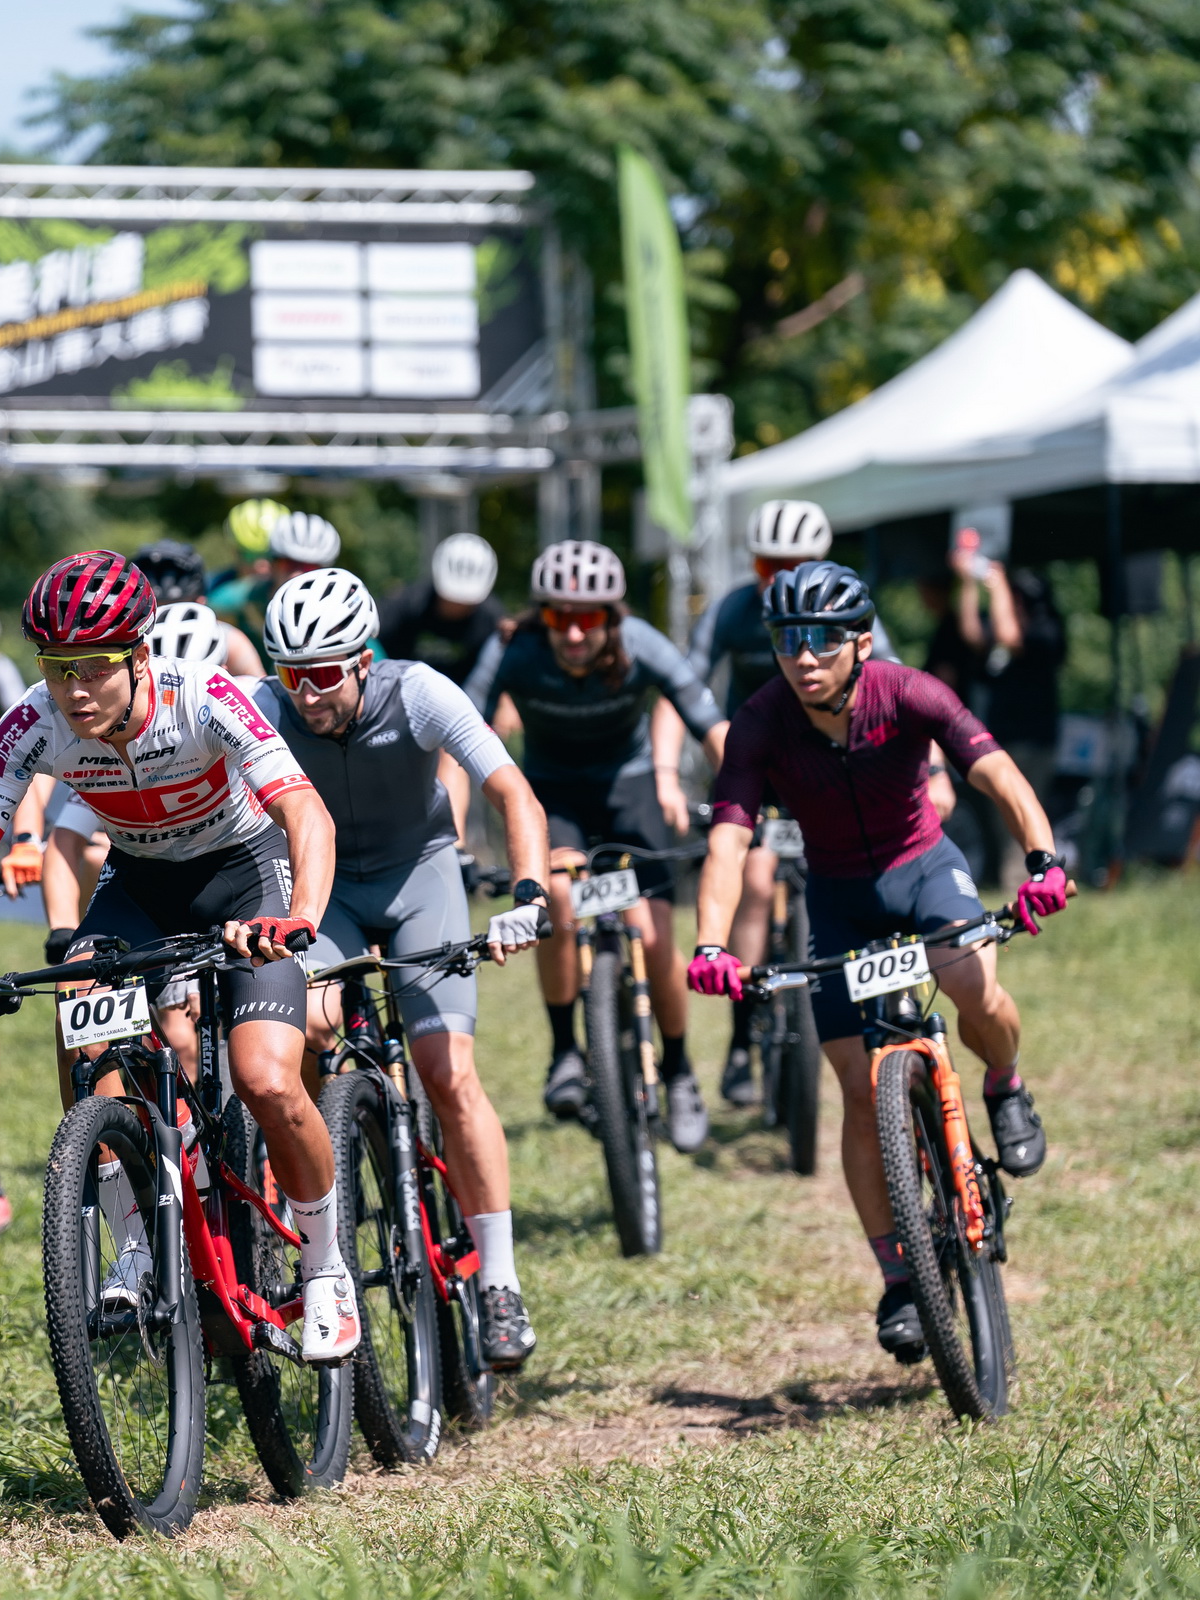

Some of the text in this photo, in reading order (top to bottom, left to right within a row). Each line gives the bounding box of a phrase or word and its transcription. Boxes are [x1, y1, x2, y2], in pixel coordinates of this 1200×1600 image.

[857, 950, 918, 984] 009
[70, 990, 137, 1031] 001
[233, 1001, 295, 1020] SUNVOLT
[93, 1031, 106, 1039] TOKI
[106, 1027, 128, 1036] SAWADA
